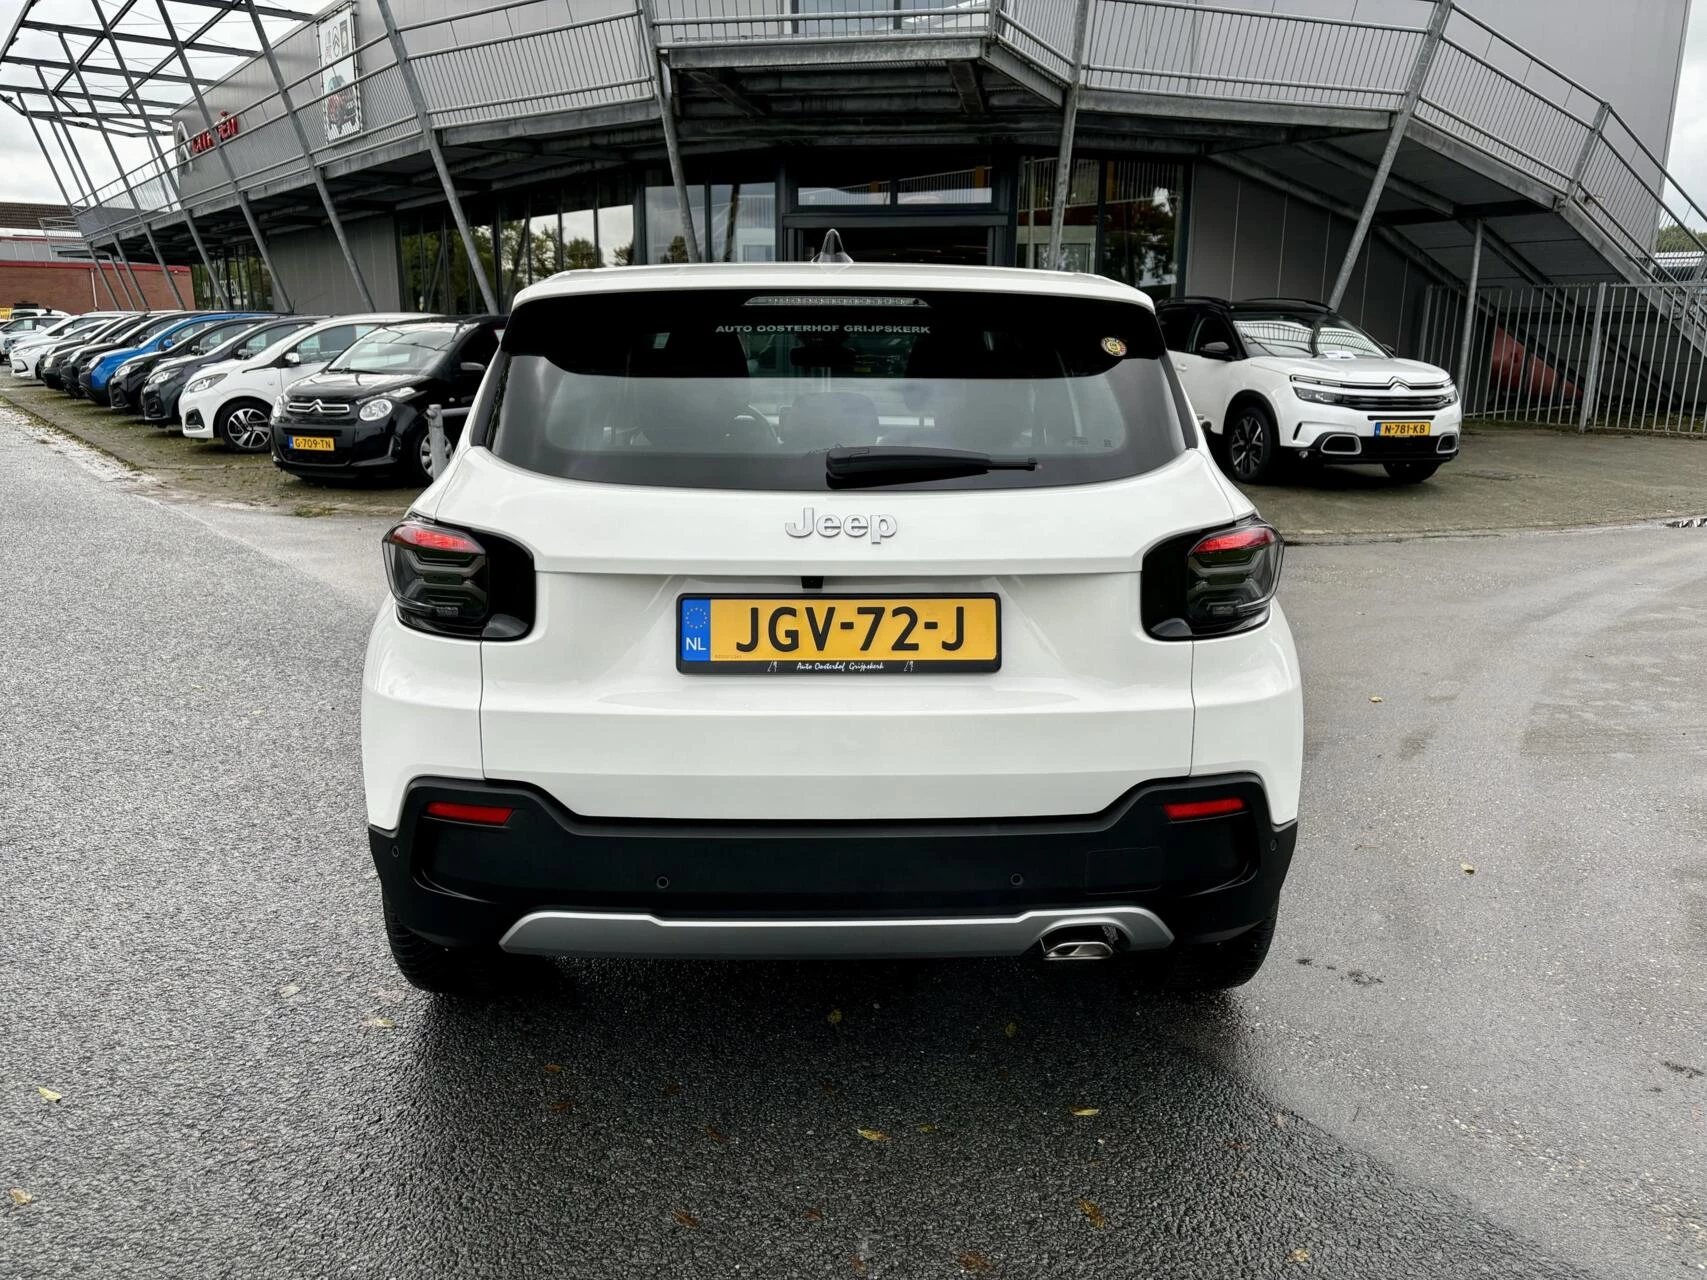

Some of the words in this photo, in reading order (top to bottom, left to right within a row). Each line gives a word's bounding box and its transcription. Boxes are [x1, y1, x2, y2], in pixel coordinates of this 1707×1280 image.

[715, 325, 753, 333] AUTO
[756, 324, 840, 333] OOSTERHOF
[843, 324, 931, 334] GRIJPSKERK
[1384, 424, 1426, 435] N-781-KB
[295, 438, 332, 449] G-709-TN
[784, 507, 898, 545] Jeep
[736, 606, 965, 652] JGV-72-J
[685, 637, 707, 651] NL
[796, 662, 812, 671] Auto
[814, 662, 846, 672] Oosterhof
